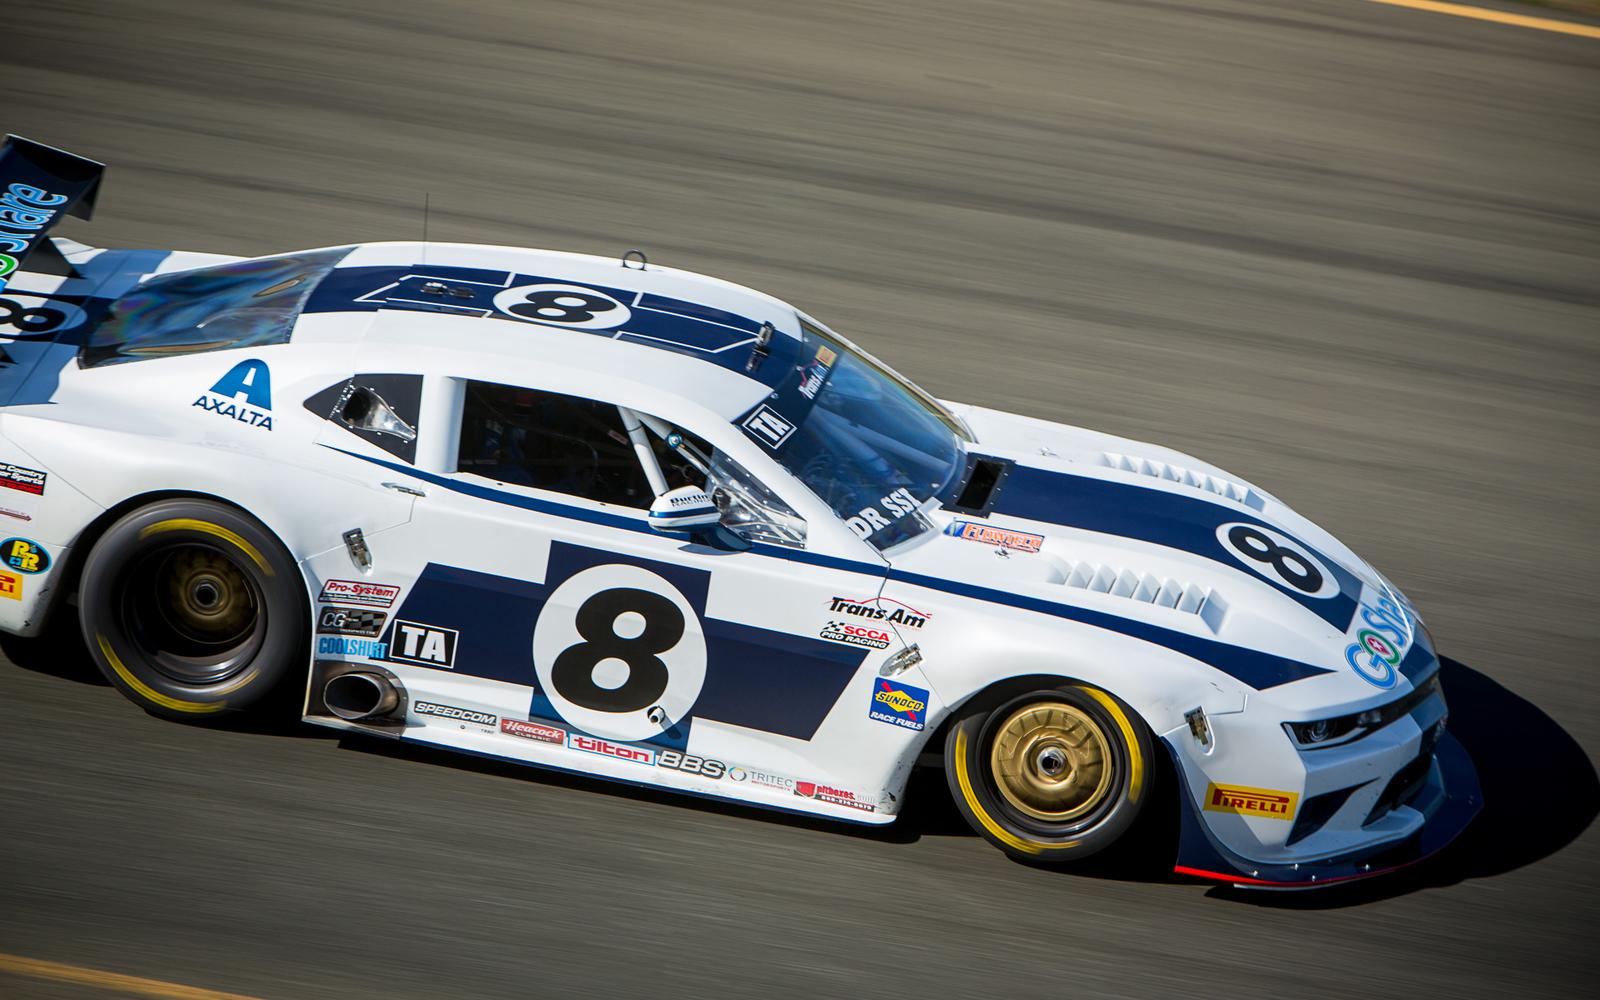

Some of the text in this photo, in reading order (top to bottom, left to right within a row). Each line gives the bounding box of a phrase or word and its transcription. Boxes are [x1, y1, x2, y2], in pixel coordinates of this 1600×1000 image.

[508, 290, 617, 323] 8
[192, 395, 273, 431] AXALTA
[749, 411, 791, 442] TA
[6, 465, 46, 480] Country
[10, 472, 45, 486] Sports
[1228, 525, 1323, 593] 8
[327, 582, 394, 598] Pro-System
[322, 611, 348, 628] CG
[829, 596, 926, 629] Trans Am
[401, 625, 447, 663] TA
[821, 631, 888, 650] PRO RACING
[844, 625, 890, 642] SCCA
[319, 637, 388, 659] COOLSHIRT
[551, 587, 686, 713] 8
[878, 692, 923, 711] SUNOCO
[414, 702, 496, 725] SPEEDCOM
[870, 711, 924, 730] RACE FUELS
[503, 720, 561, 740] Heacock
[574, 736, 649, 763] tilton
[657, 750, 727, 779] BBS
[750, 770, 793, 788] TRITEC
[1211, 788, 1290, 814] PIRELLI
